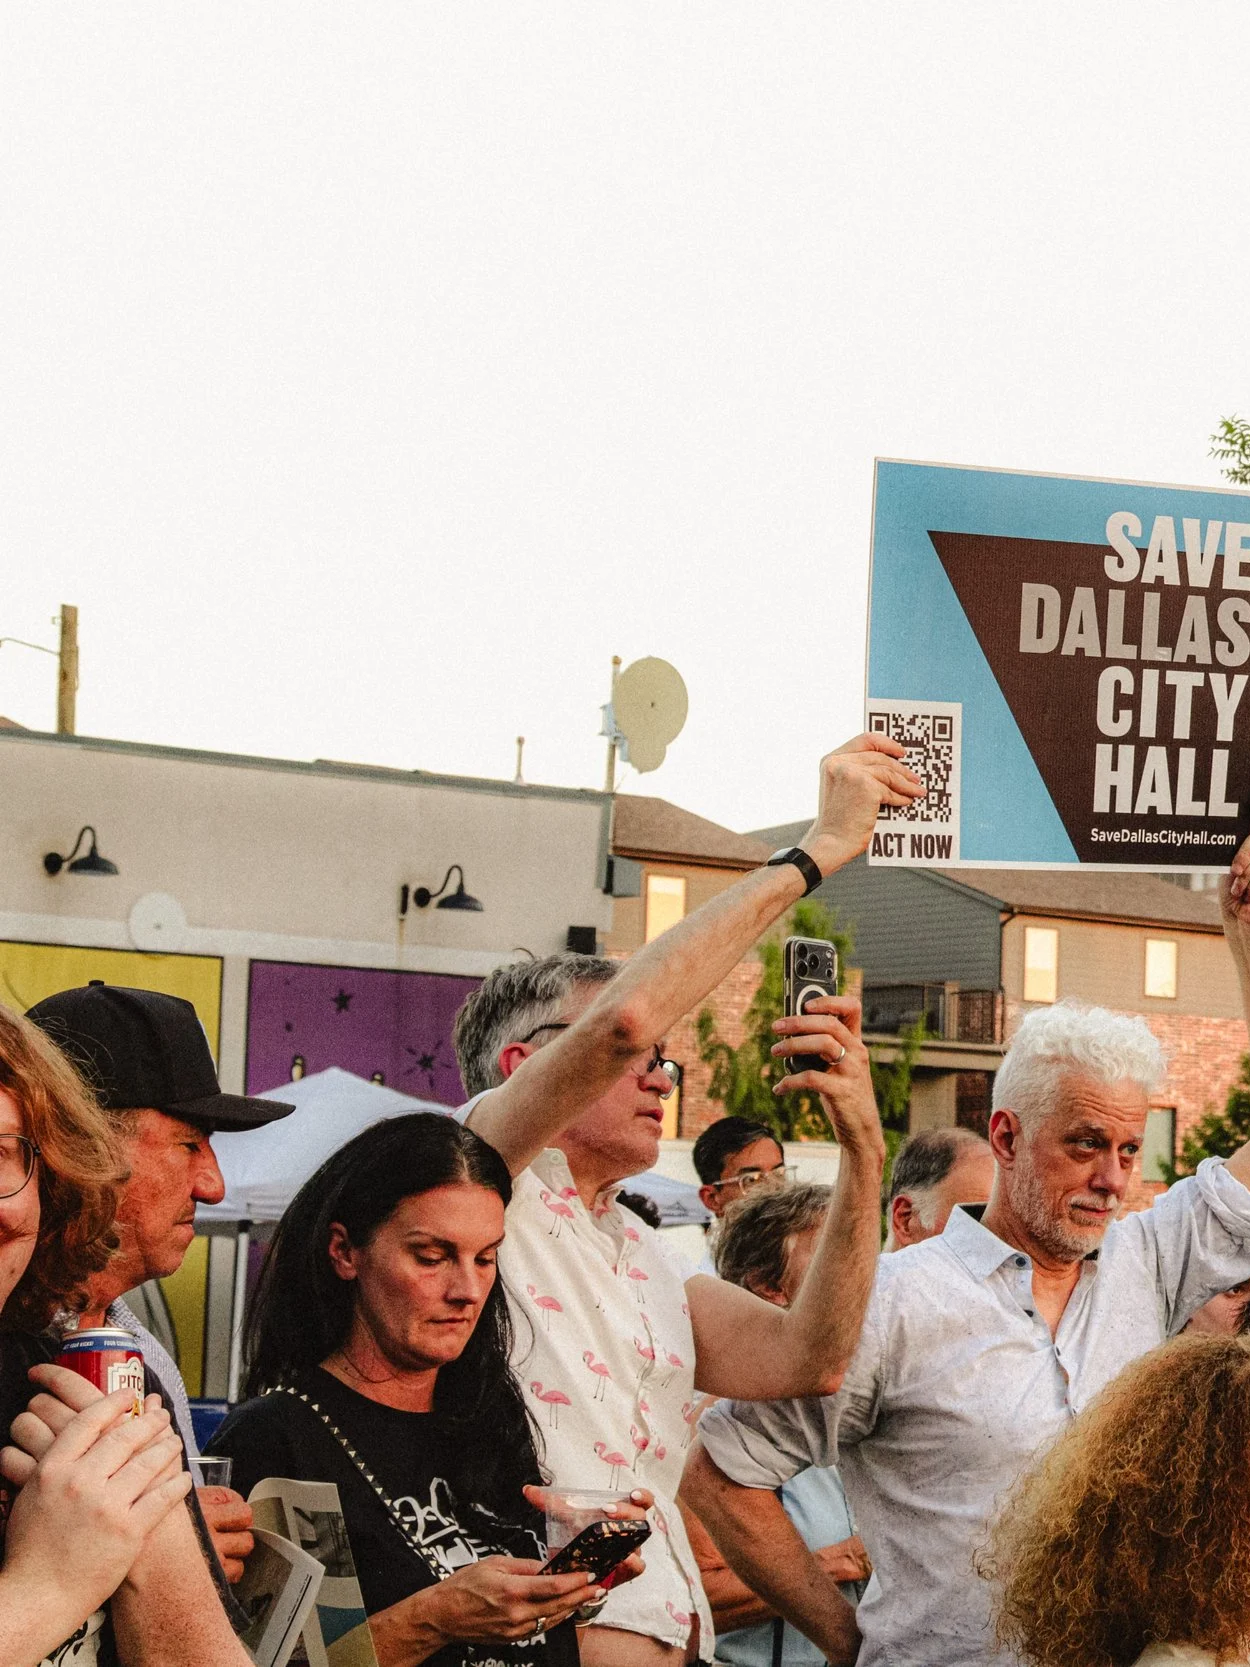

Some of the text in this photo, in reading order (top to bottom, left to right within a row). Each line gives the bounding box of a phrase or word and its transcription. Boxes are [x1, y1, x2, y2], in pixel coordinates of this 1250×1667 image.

[1096, 666, 1249, 741] CITY
[1093, 743, 1239, 817] HALL
[871, 832, 953, 859] ACT NOW
[1090, 828, 1236, 847] SaveDallasCityHall.com
[118, 1374, 143, 1392] PITC
